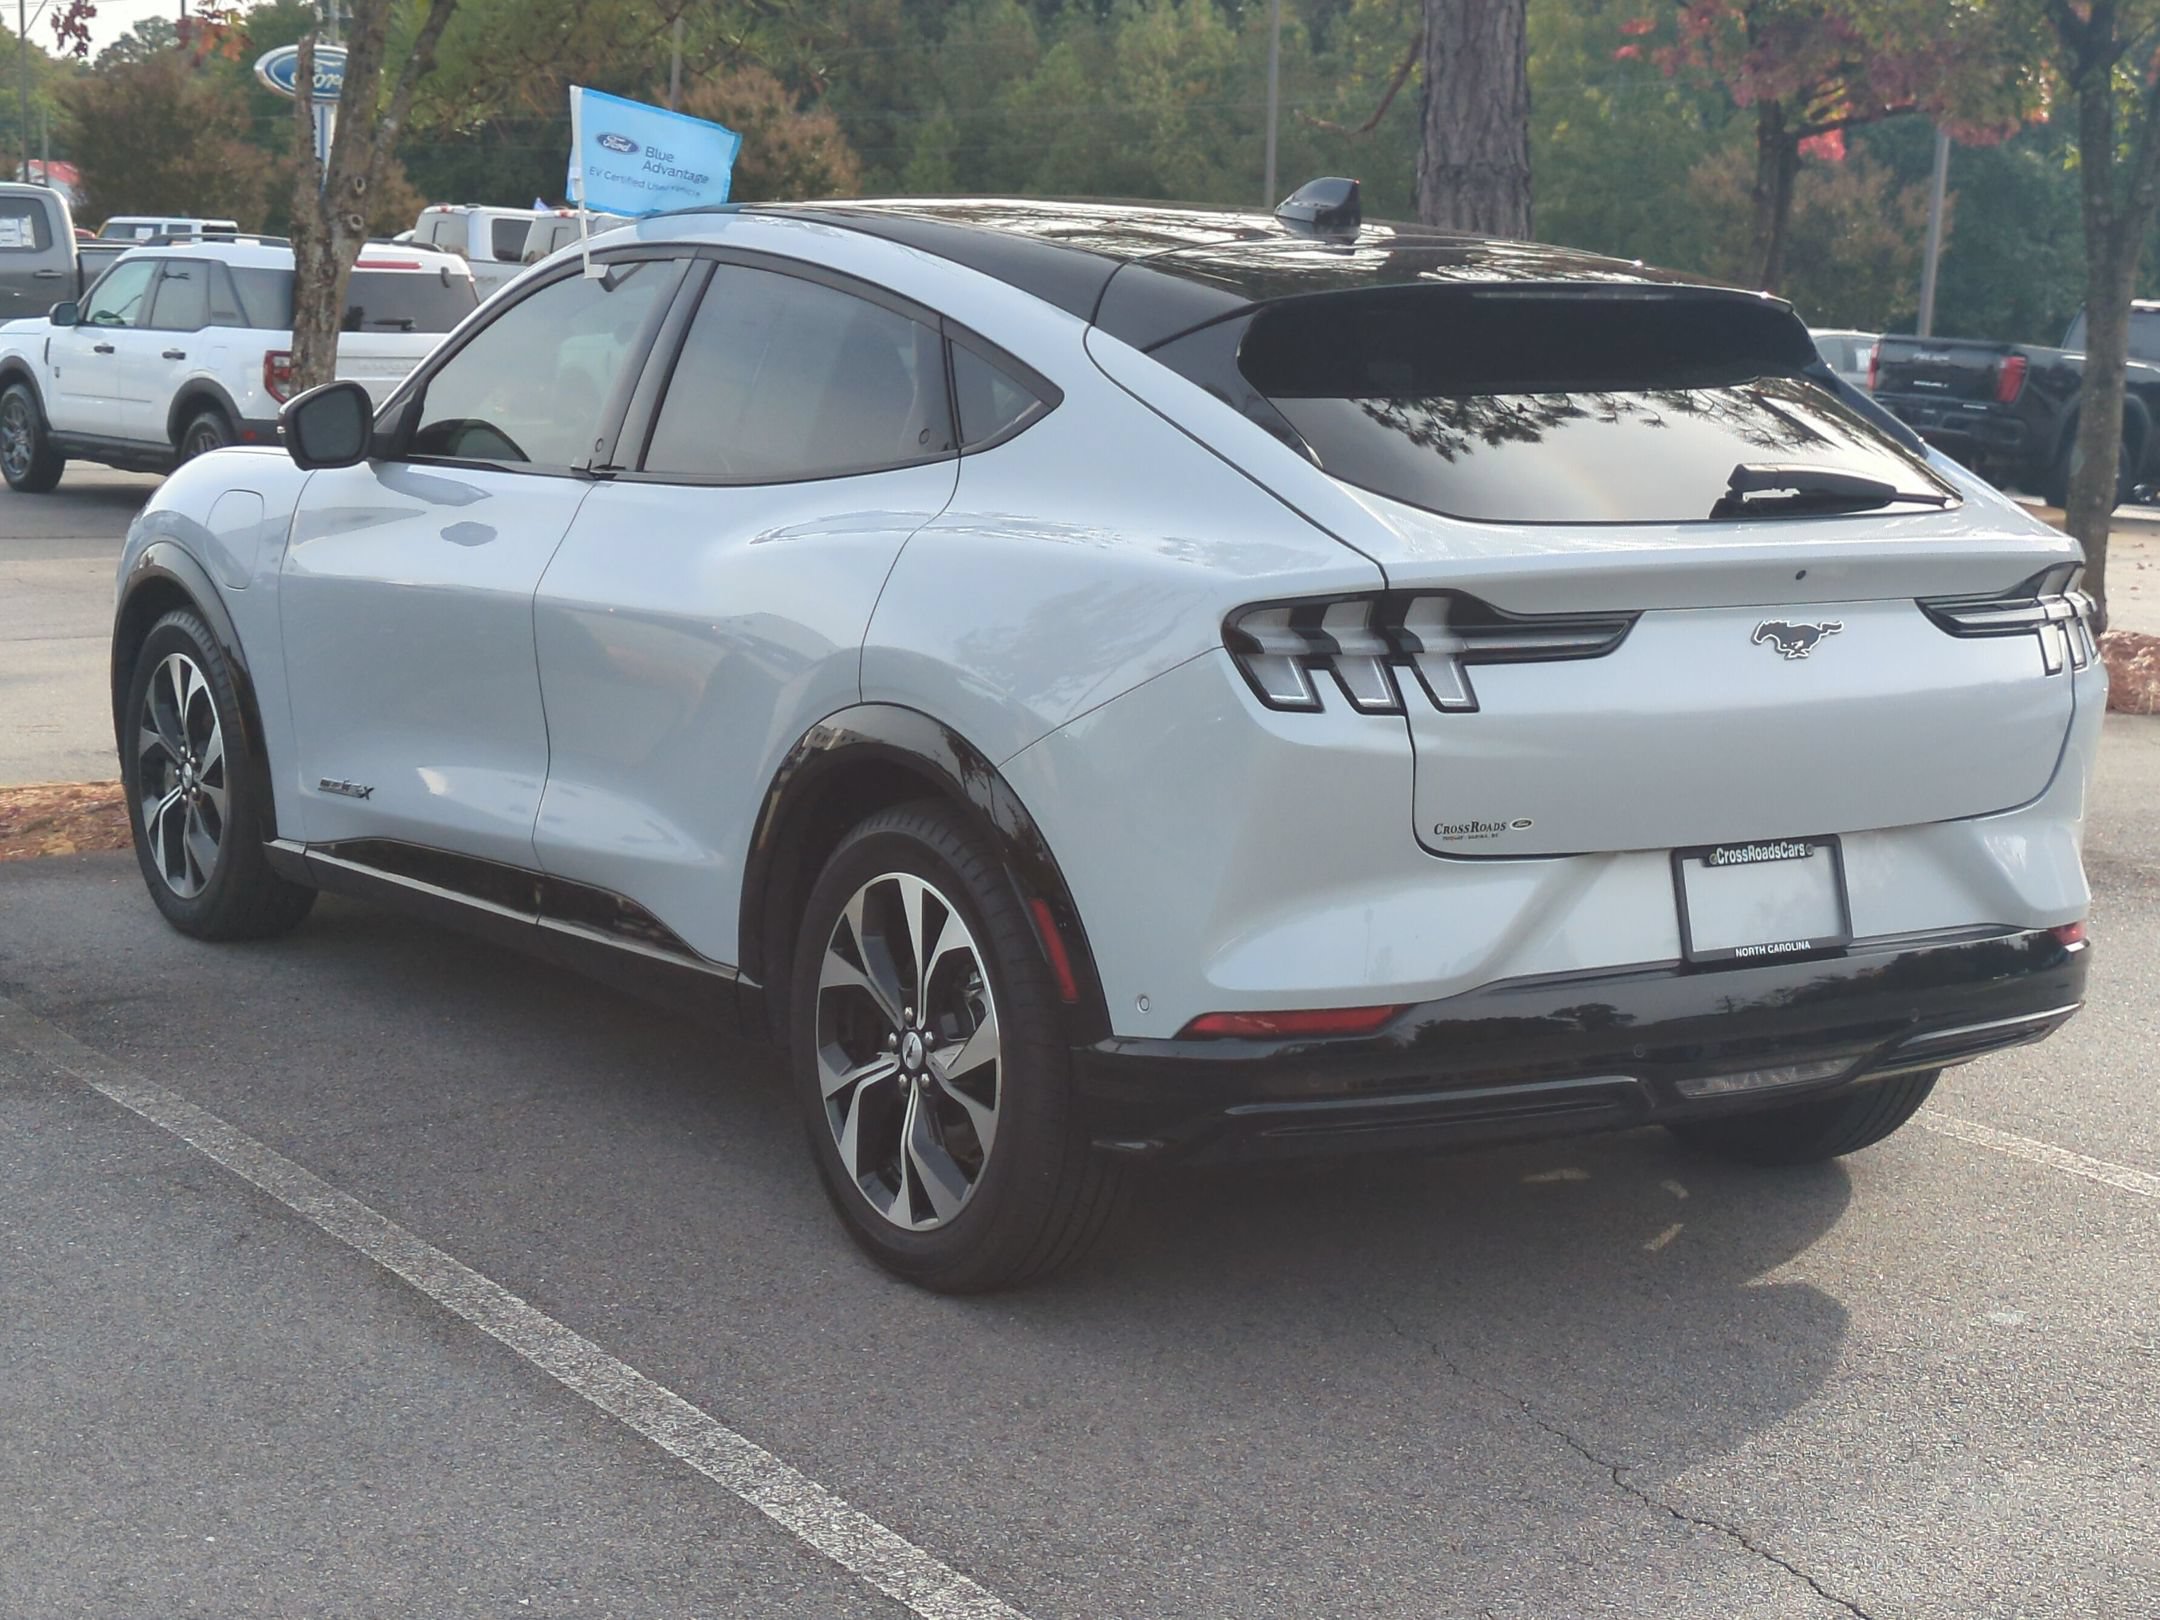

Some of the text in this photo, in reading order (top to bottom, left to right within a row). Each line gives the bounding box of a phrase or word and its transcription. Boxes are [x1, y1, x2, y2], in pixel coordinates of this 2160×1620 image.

[602, 135, 632, 152] Ford
[645, 146, 674, 162] Blue
[589, 166, 602, 176] EV
[642, 160, 710, 184] Advantage
[1433, 821, 1506, 836] CROSSROADS
[1716, 842, 1806, 865] CrossRoadsCars
[1735, 940, 1811, 957] NORTH CAROLINA
